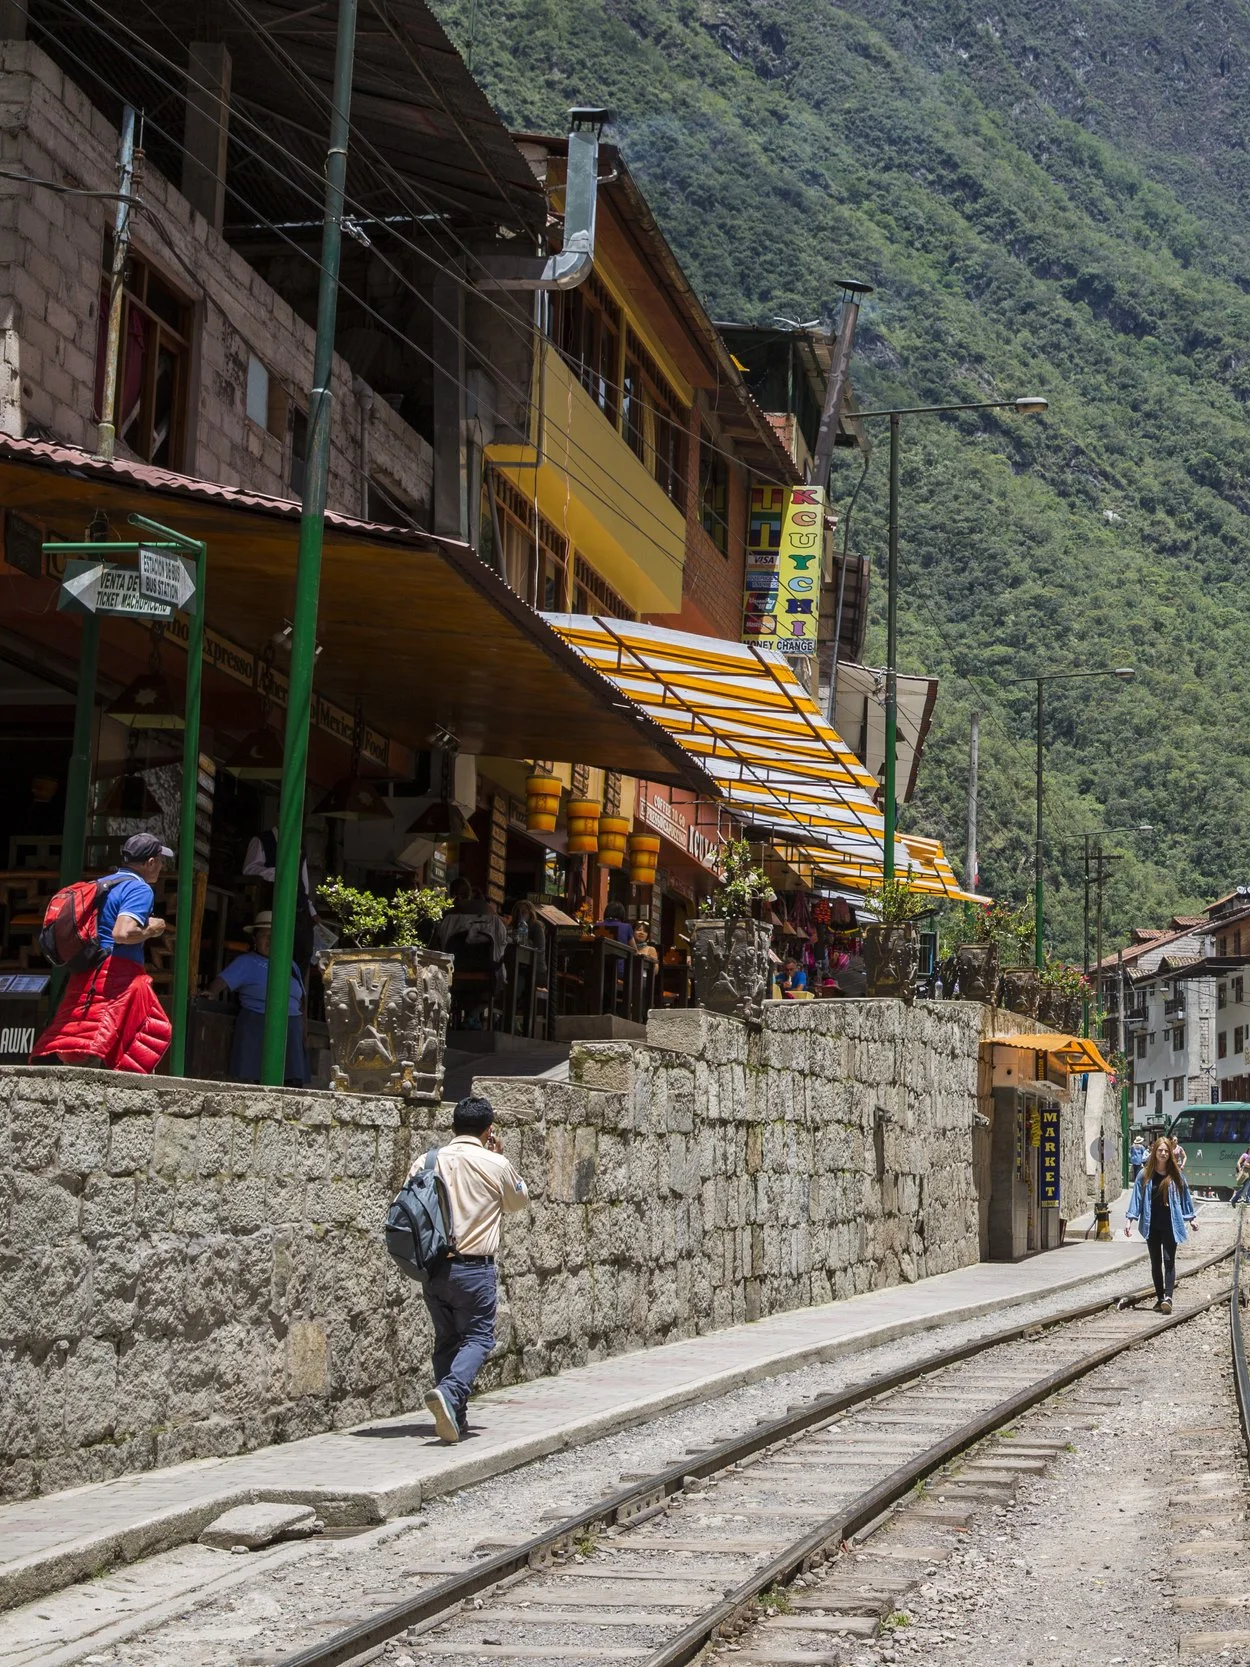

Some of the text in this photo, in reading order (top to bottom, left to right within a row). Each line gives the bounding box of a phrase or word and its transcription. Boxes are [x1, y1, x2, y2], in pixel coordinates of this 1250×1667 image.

[754, 556, 776, 565] VISA
[785, 489, 818, 637] KCUYCHI
[100, 571, 125, 591] VENTA
[145, 576, 179, 600] BUS STATION
[96, 591, 120, 607] TICKET
[777, 641, 814, 652] CHANGE
[1043, 1111, 1058, 1198] MARKET
